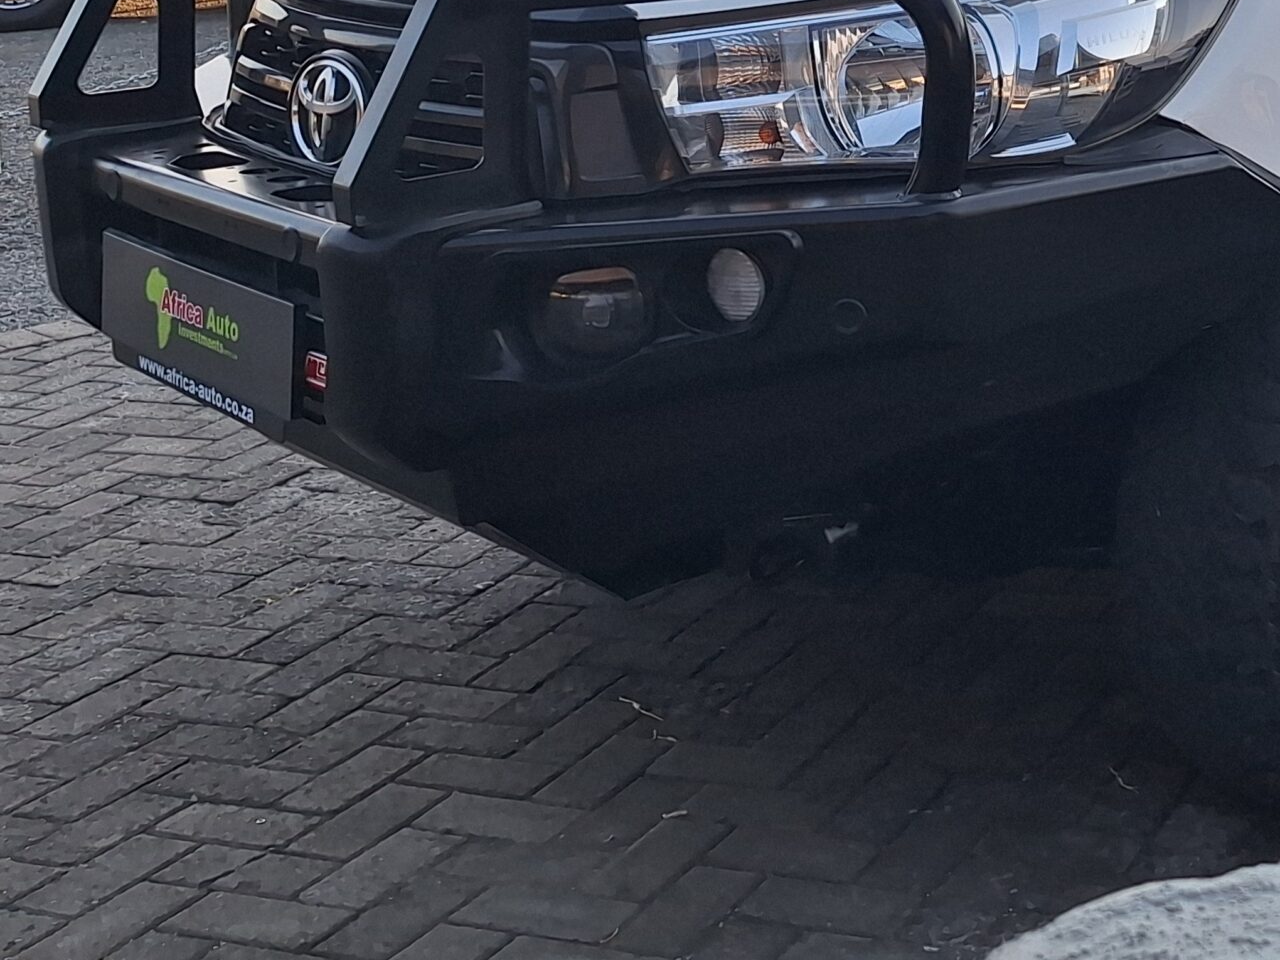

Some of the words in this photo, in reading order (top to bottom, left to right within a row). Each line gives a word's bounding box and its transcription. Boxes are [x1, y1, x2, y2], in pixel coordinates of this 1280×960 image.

[161, 287, 204, 329] Africa
[206, 306, 239, 342] Auto
[138, 355, 255, 424] www.africa-auto.co.za
